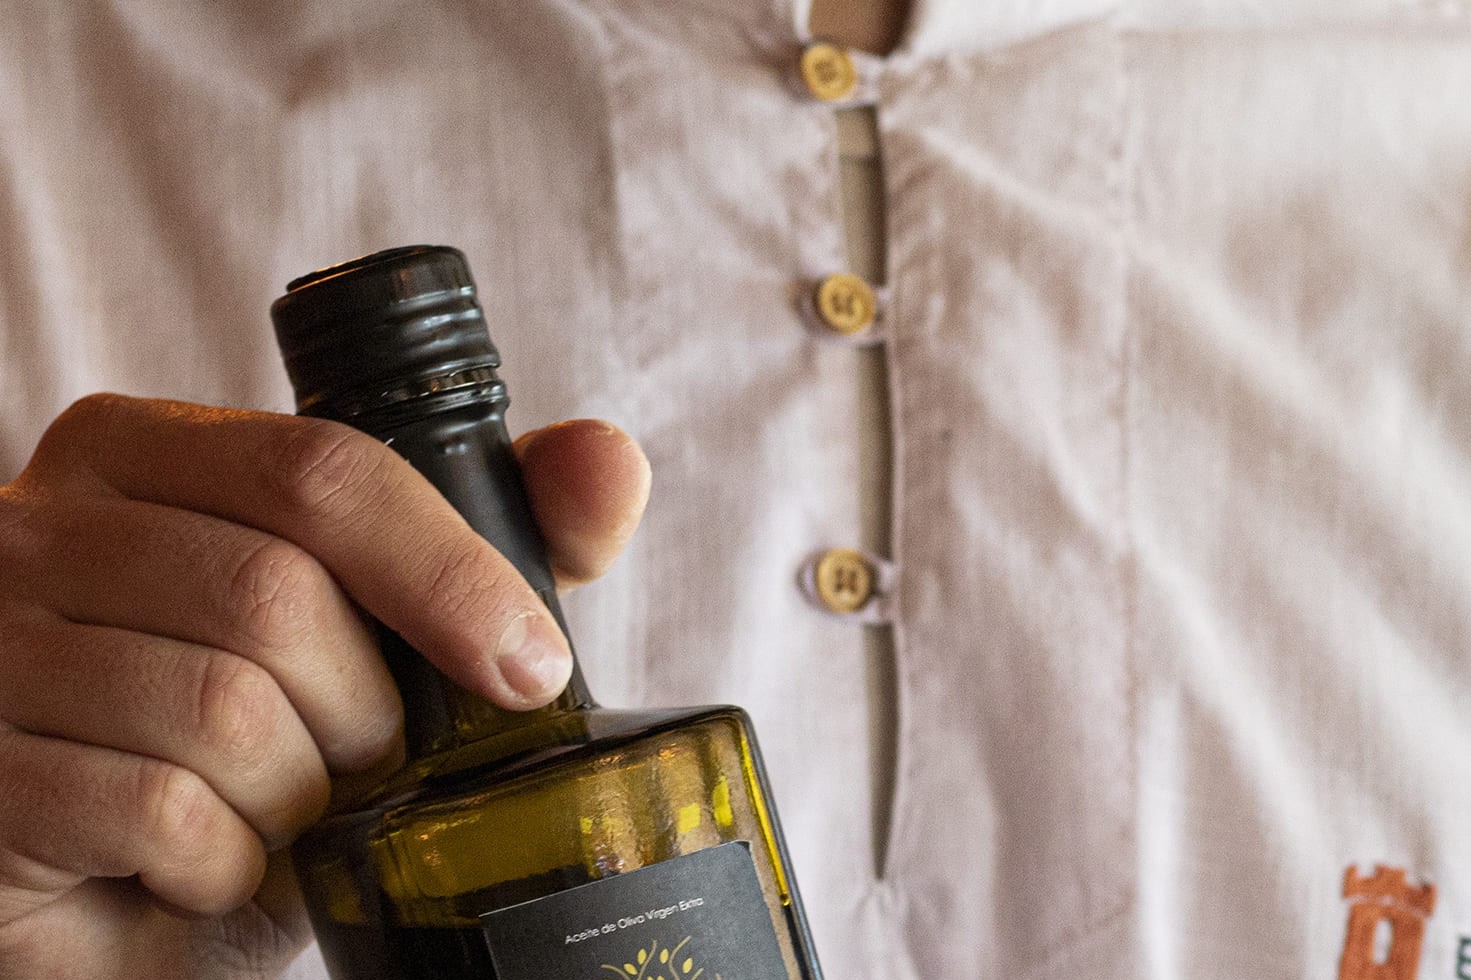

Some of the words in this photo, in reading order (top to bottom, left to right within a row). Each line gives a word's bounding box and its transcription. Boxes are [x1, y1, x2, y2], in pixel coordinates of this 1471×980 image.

[565, 926, 600, 944] Aceite
[601, 921, 617, 934] de
[617, 913, 645, 929] Oliva
[645, 904, 679, 920] Virgen
[678, 897, 704, 911] Extra
